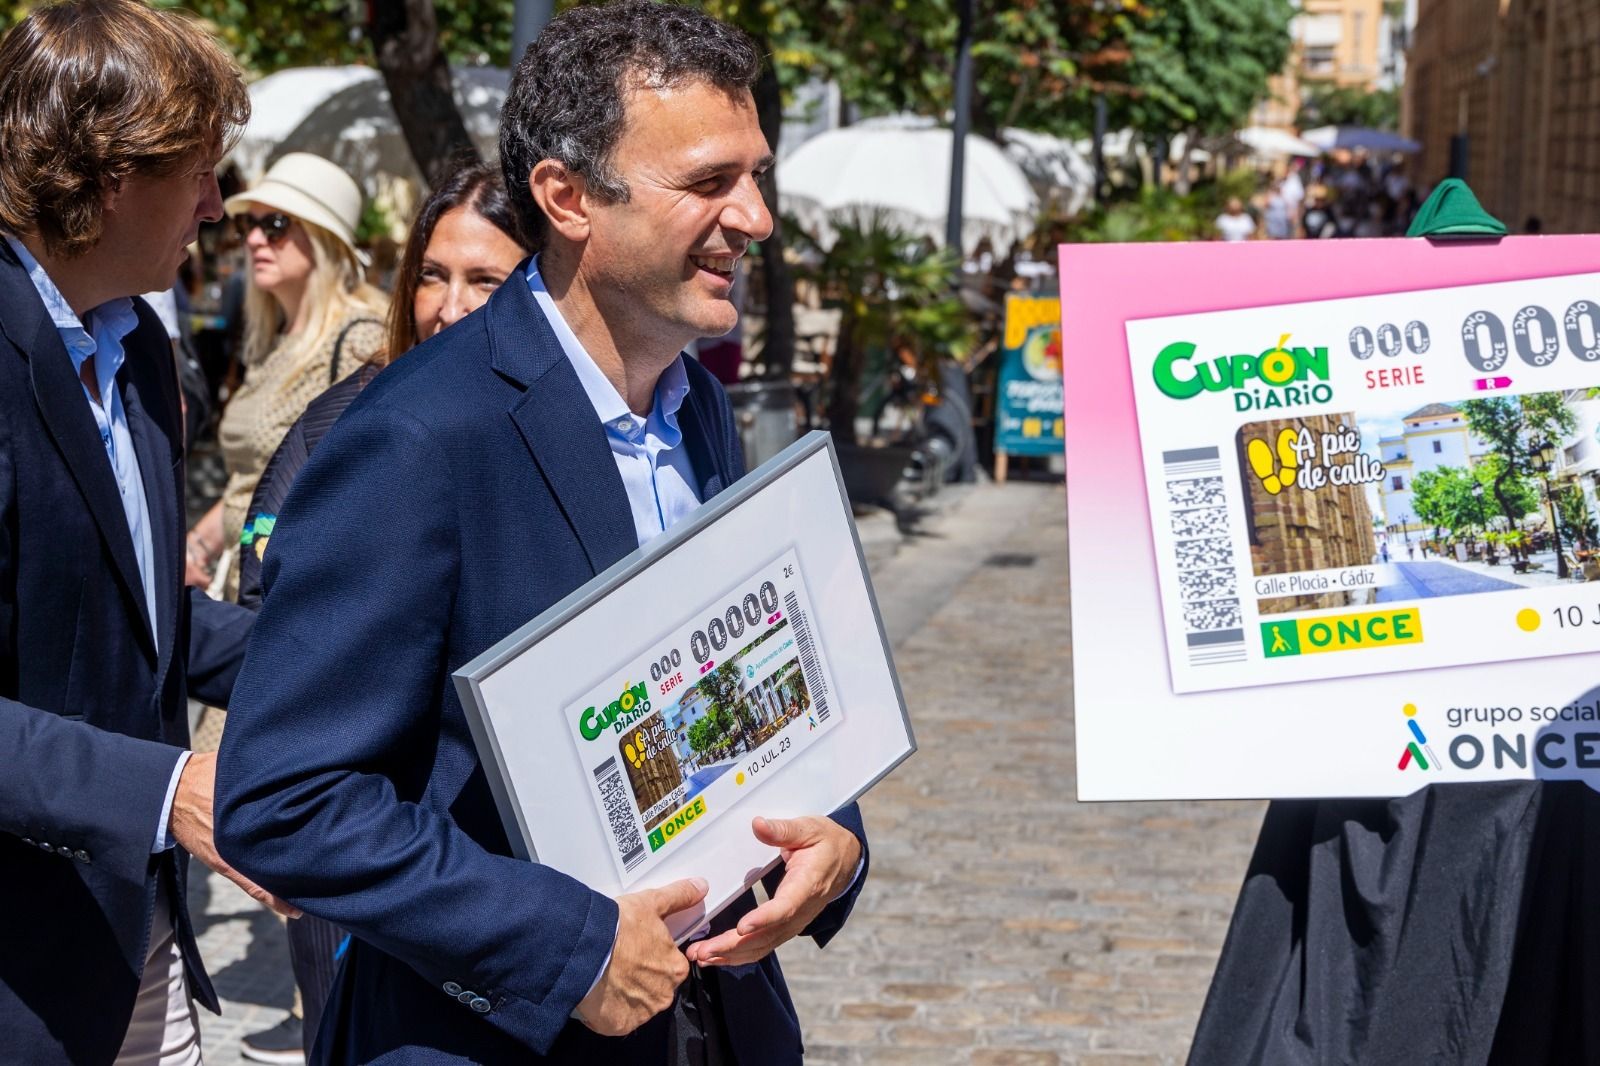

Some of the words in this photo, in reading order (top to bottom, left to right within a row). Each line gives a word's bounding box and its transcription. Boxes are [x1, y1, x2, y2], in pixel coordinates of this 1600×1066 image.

[1463, 312, 1486, 340] ONCE
[1514, 307, 1537, 335] ONCE
[1565, 302, 1588, 330] ONCE
[1348, 320, 1431, 360] 000
[1534, 337, 1557, 365] ONCE
[1483, 342, 1506, 370] ONCE
[1365, 365, 1425, 389] SERIE
[1485, 378, 1496, 389] R
[1289, 427, 1316, 465] A
[1321, 425, 1360, 467] pie
[1297, 459, 1327, 490] de
[1329, 454, 1386, 486] calle
[783, 564, 794, 579] 2€
[1255, 578, 1286, 596] Calle
[1289, 574, 1329, 592] Plocia
[1340, 569, 1376, 587] Cádiz
[690, 581, 778, 664] 00000
[1308, 614, 1414, 647] ONCE
[1553, 605, 1583, 628] 10
[650, 648, 681, 681] 000
[660, 672, 683, 695] SERIE
[1447, 707, 1523, 728] grupo
[1530, 700, 1600, 722] social
[640, 728, 651, 748] A
[651, 719, 666, 743] pie
[646, 743, 657, 760] de
[657, 729, 678, 751] calle
[747, 761, 759, 776] 10
[779, 737, 791, 753] 23
[1448, 732, 1600, 770] ONCE
[641, 810, 655, 823] Calle
[665, 800, 703, 836] ONCE
